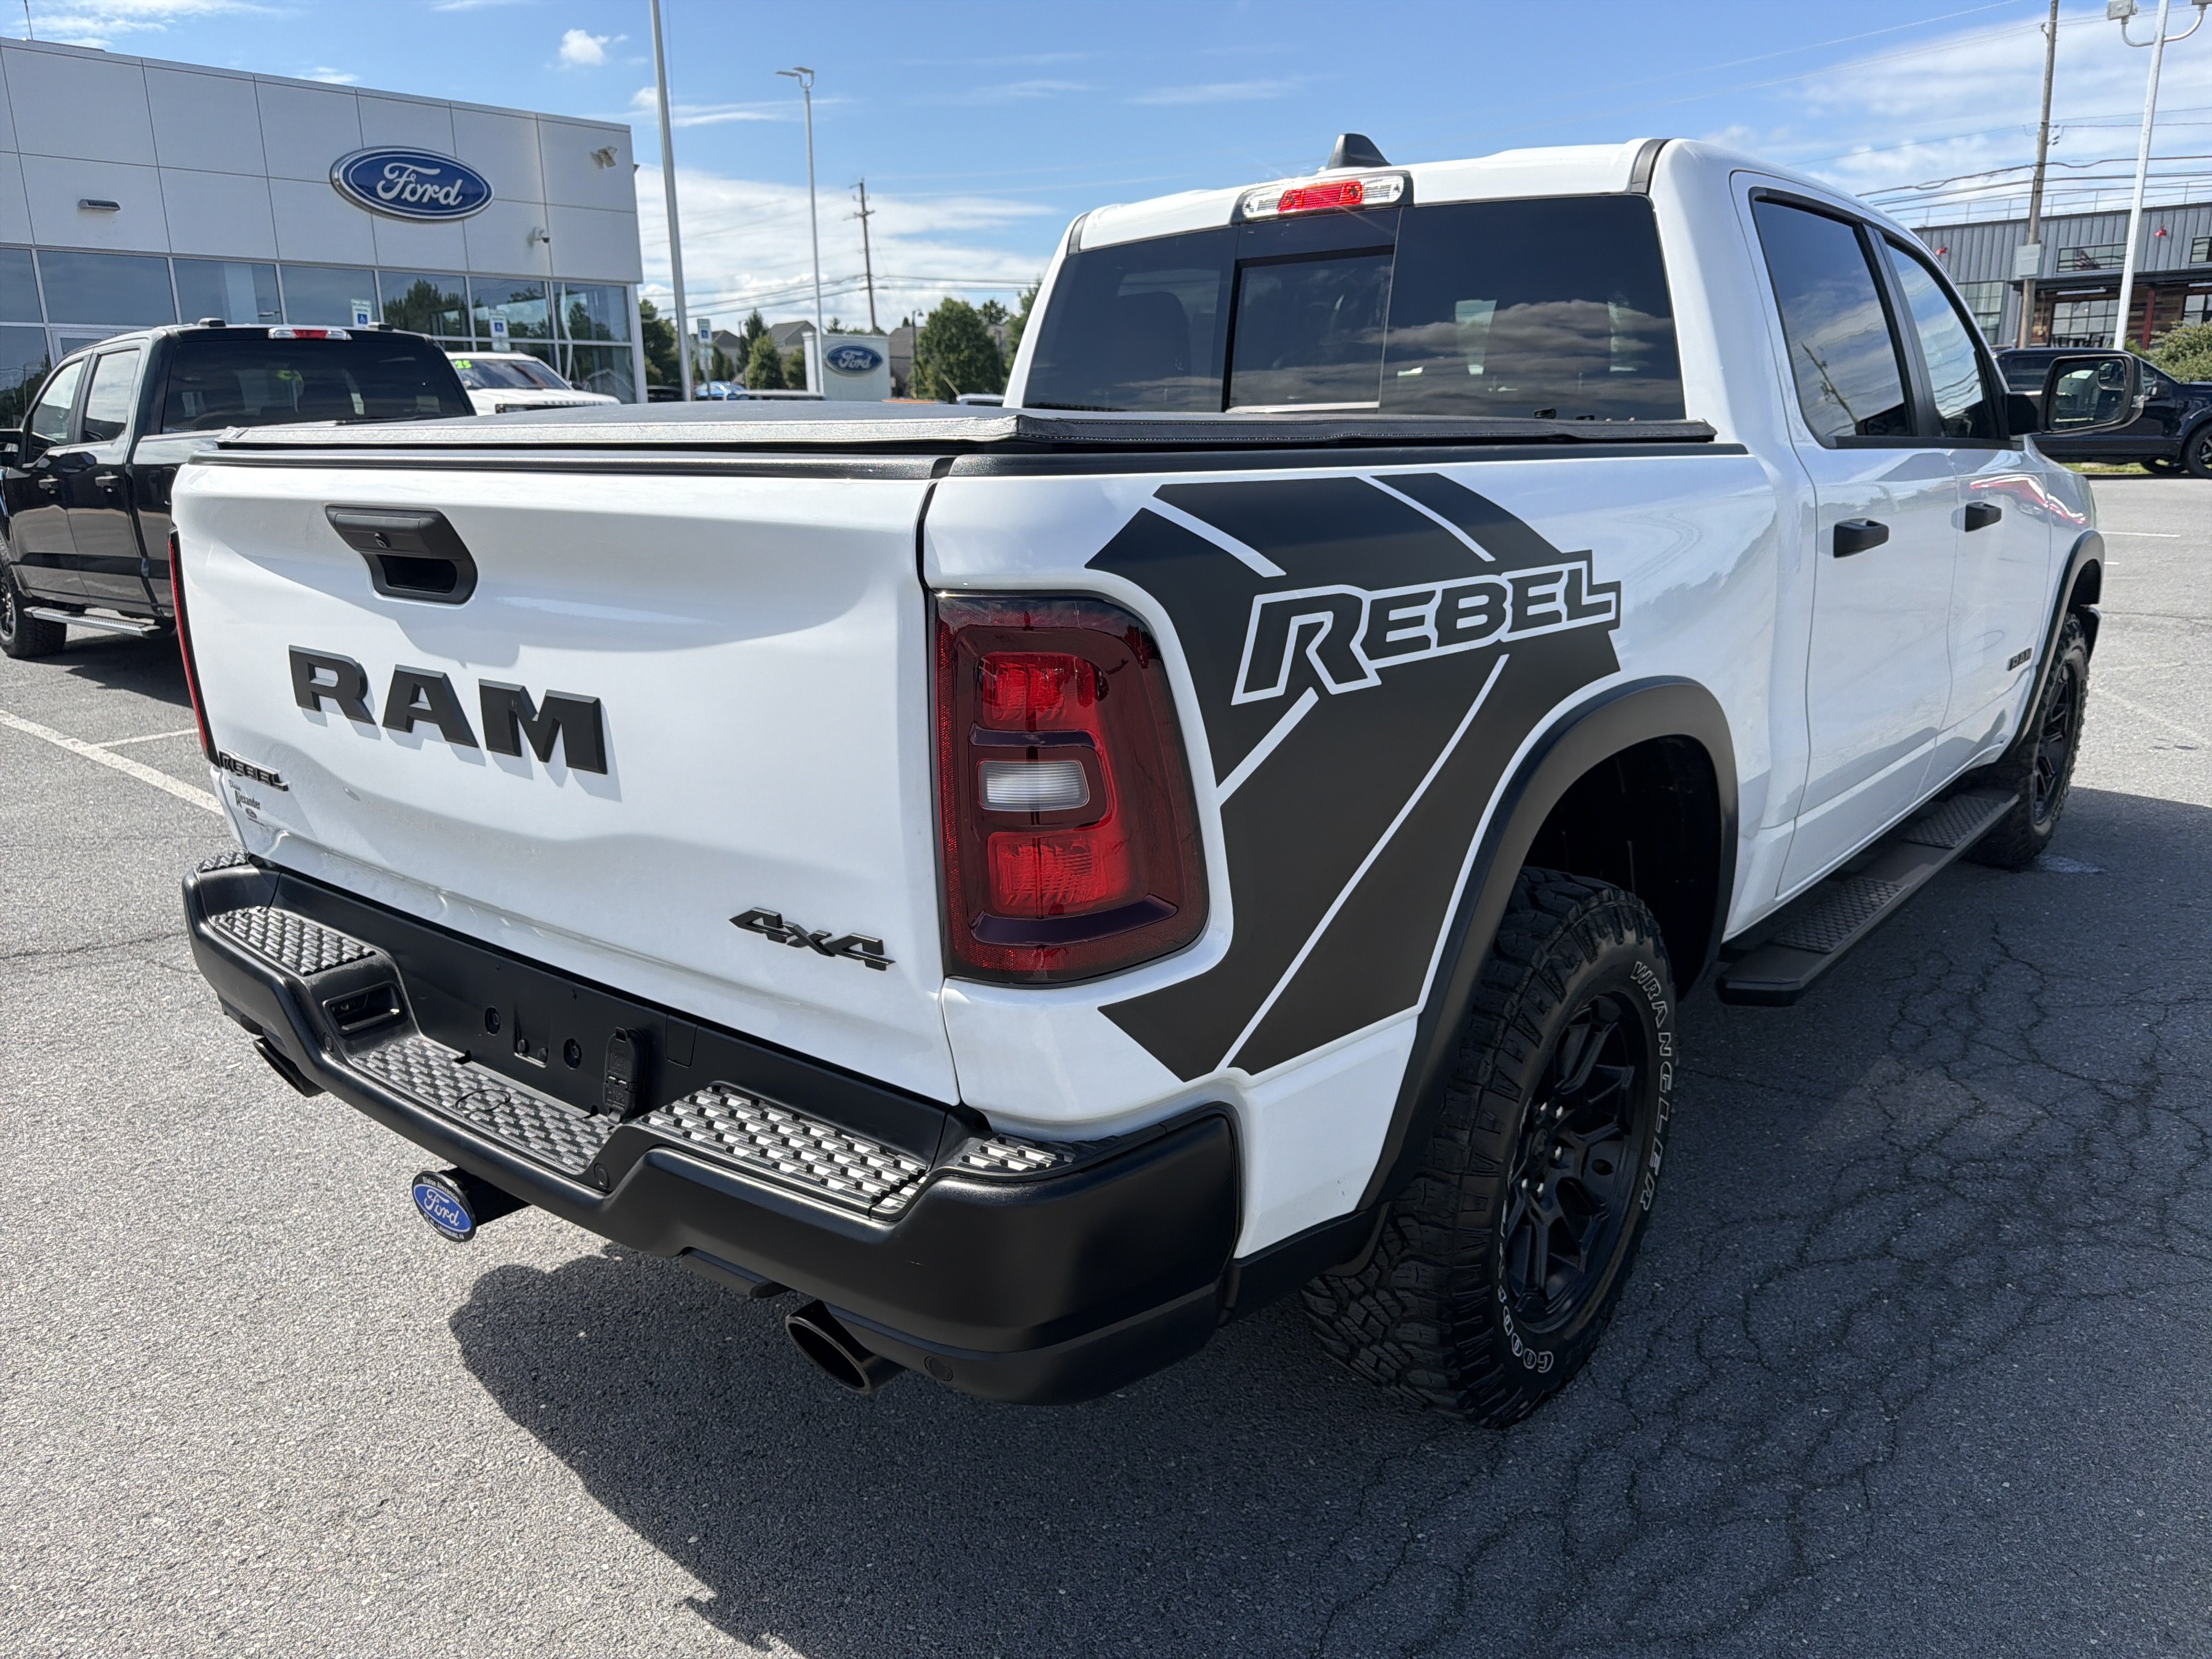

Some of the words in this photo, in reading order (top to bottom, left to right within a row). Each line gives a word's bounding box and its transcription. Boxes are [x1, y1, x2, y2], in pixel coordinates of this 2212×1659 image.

[376, 162, 464, 206] Ford
[455, 360, 472, 369] 25
[838, 351, 872, 369] Ford
[1232, 560, 1617, 706] REBEL
[289, 644, 608, 775] RAM
[219, 750, 289, 792] REBEL
[1629, 961, 1672, 1211] WRANGLER
[424, 1188, 460, 1227] Ford
